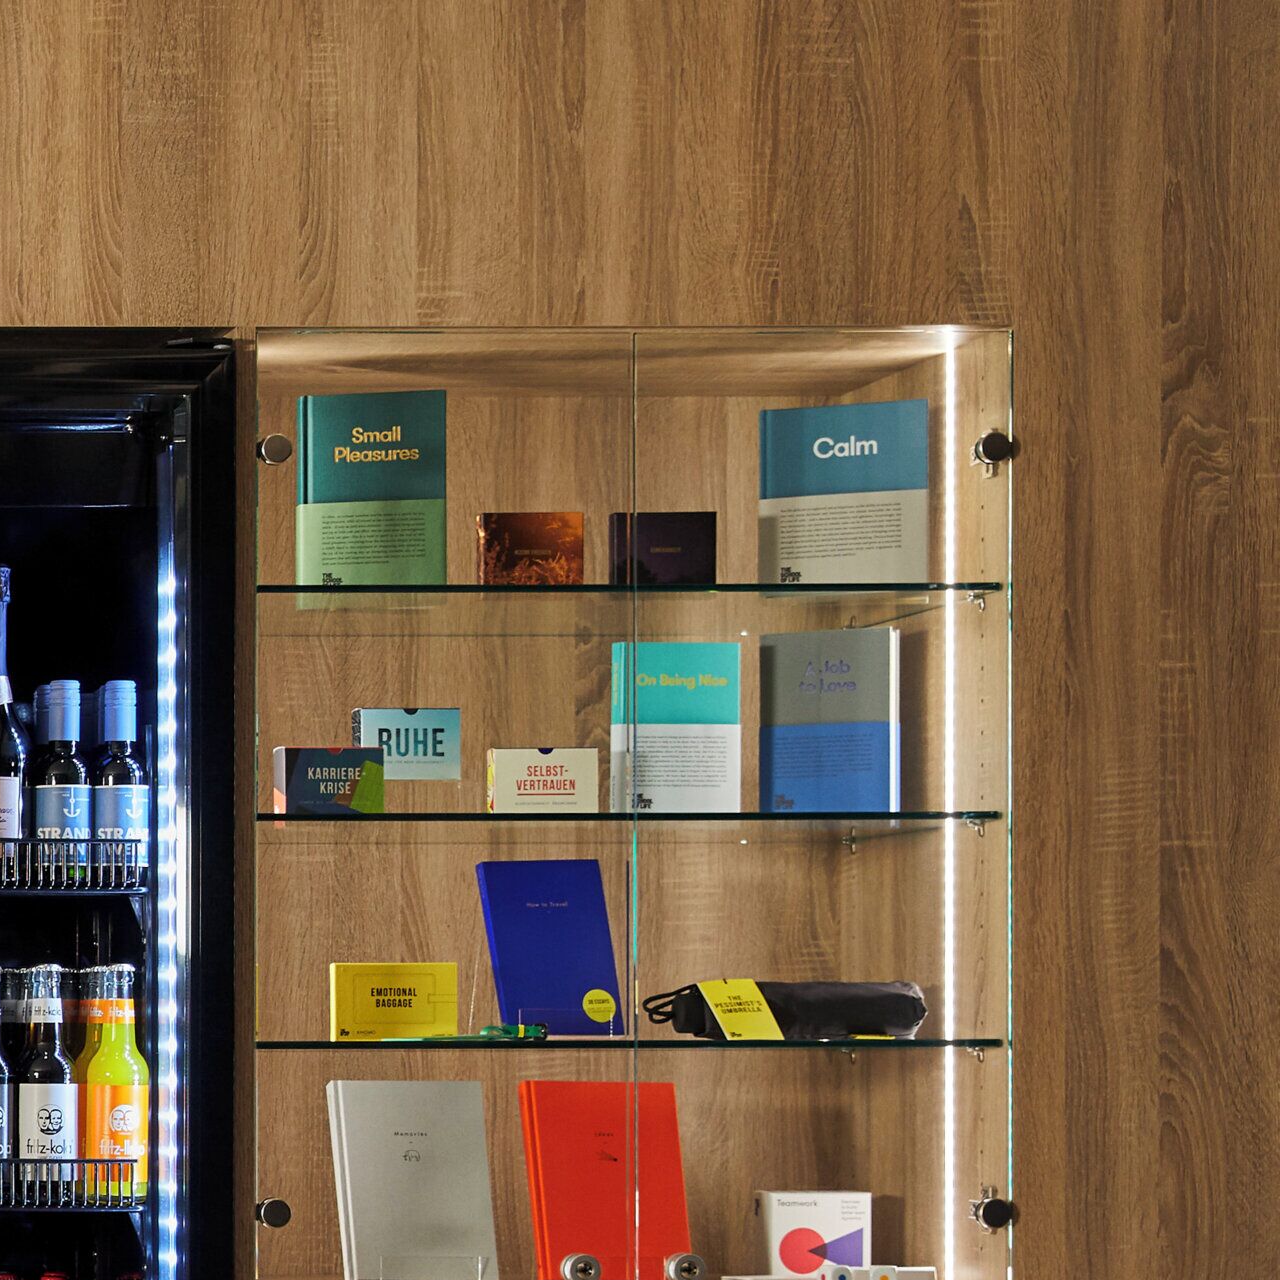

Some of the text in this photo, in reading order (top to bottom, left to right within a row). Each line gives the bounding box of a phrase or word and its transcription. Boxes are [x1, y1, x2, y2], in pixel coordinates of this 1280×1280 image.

[351, 426, 401, 444] Small
[813, 435, 879, 460] Calm
[334, 446, 420, 463] Pleasures
[805, 660, 851, 676] A Job
[636, 673, 728, 690] On Being Nice
[799, 678, 857, 692] to Love
[378, 727, 446, 757] RUHE
[308, 767, 366, 780] KARRIERE-
[526, 765, 569, 778] SELBST-
[320, 781, 352, 795] KRISE
[516, 778, 576, 791] VERTRAUEN
[37, 827, 91, 839] STRAND
[370, 987, 417, 997] EMOTIONAL
[375, 998, 413, 1008] BAGGAGE
[714, 1001, 763, 1009] PESSIMIST'S
[777, 1199, 818, 1207] Teamwork
